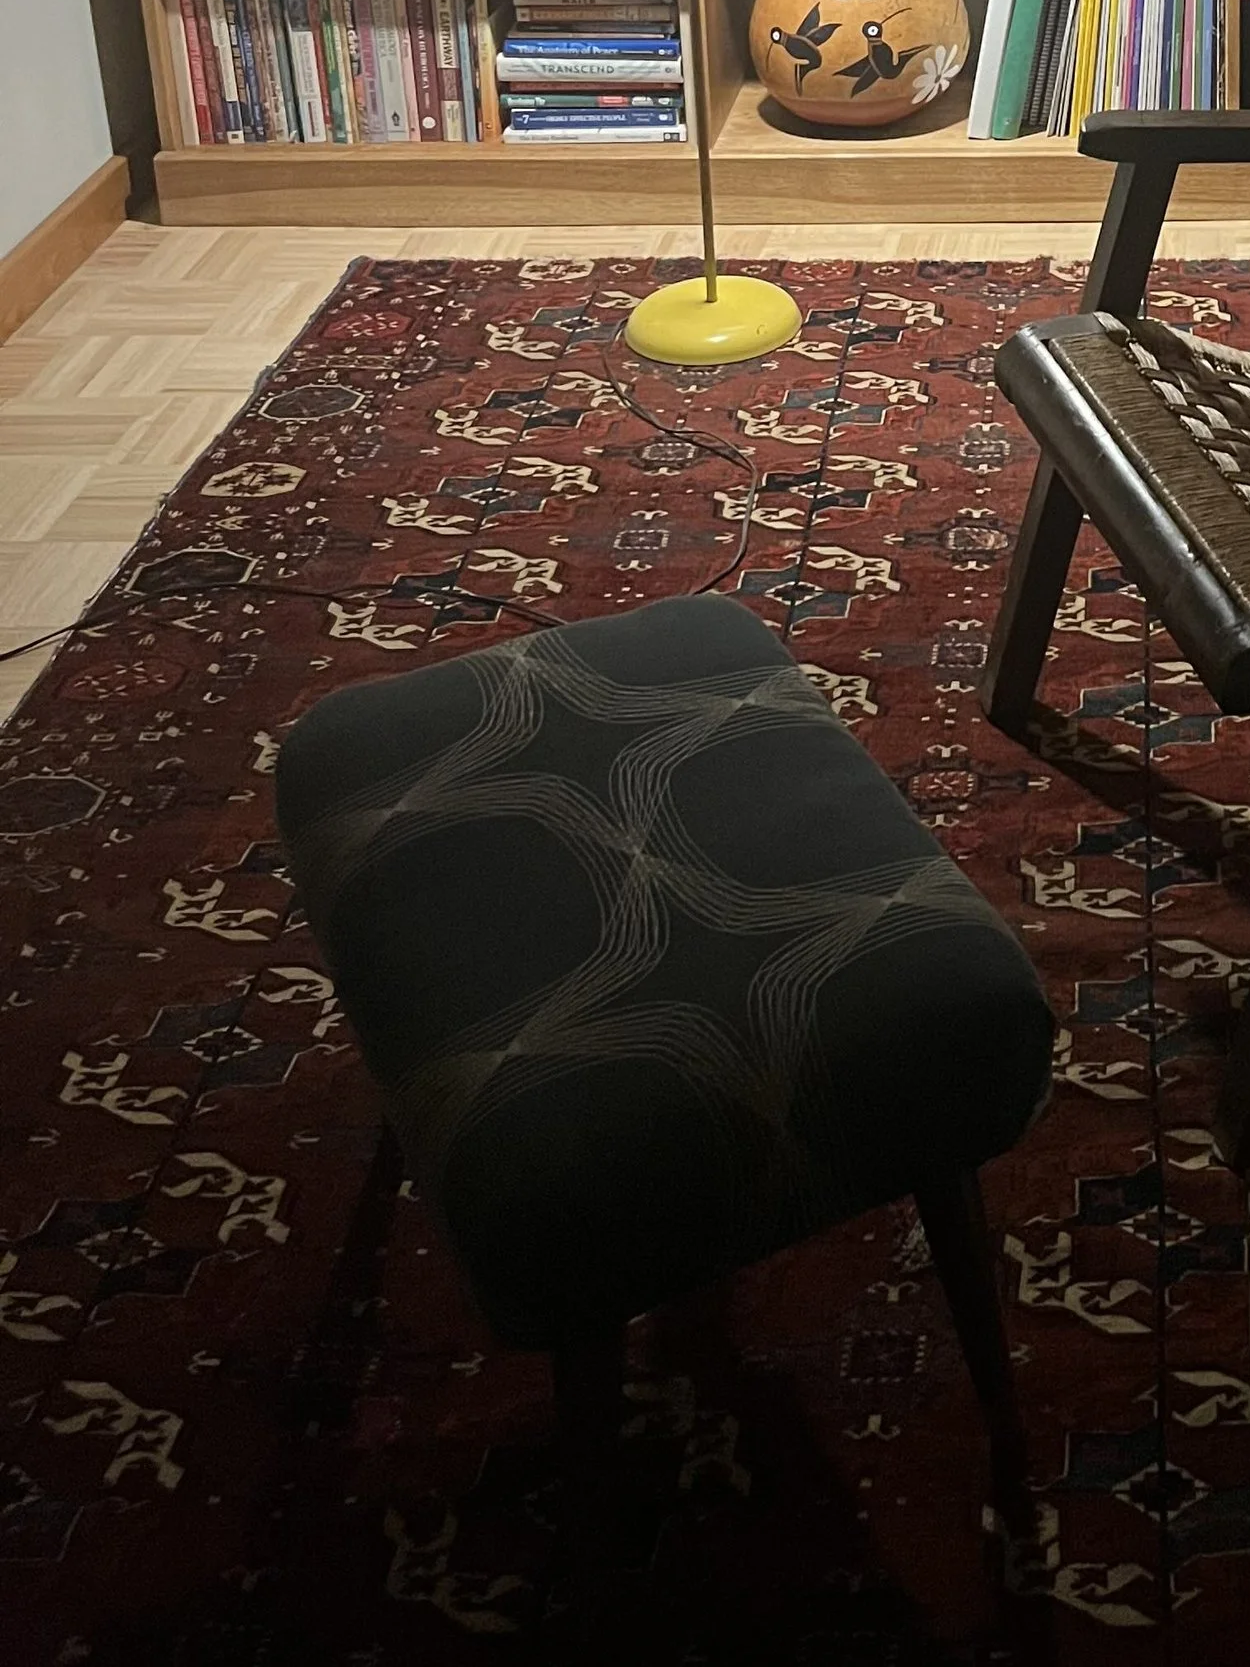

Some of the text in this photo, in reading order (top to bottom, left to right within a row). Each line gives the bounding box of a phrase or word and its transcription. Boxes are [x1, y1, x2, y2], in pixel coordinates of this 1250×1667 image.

[439, 11, 453, 66] EARTHWAY
[541, 65, 615, 74] TRANSCEND
[522, 115, 529, 124] 7
